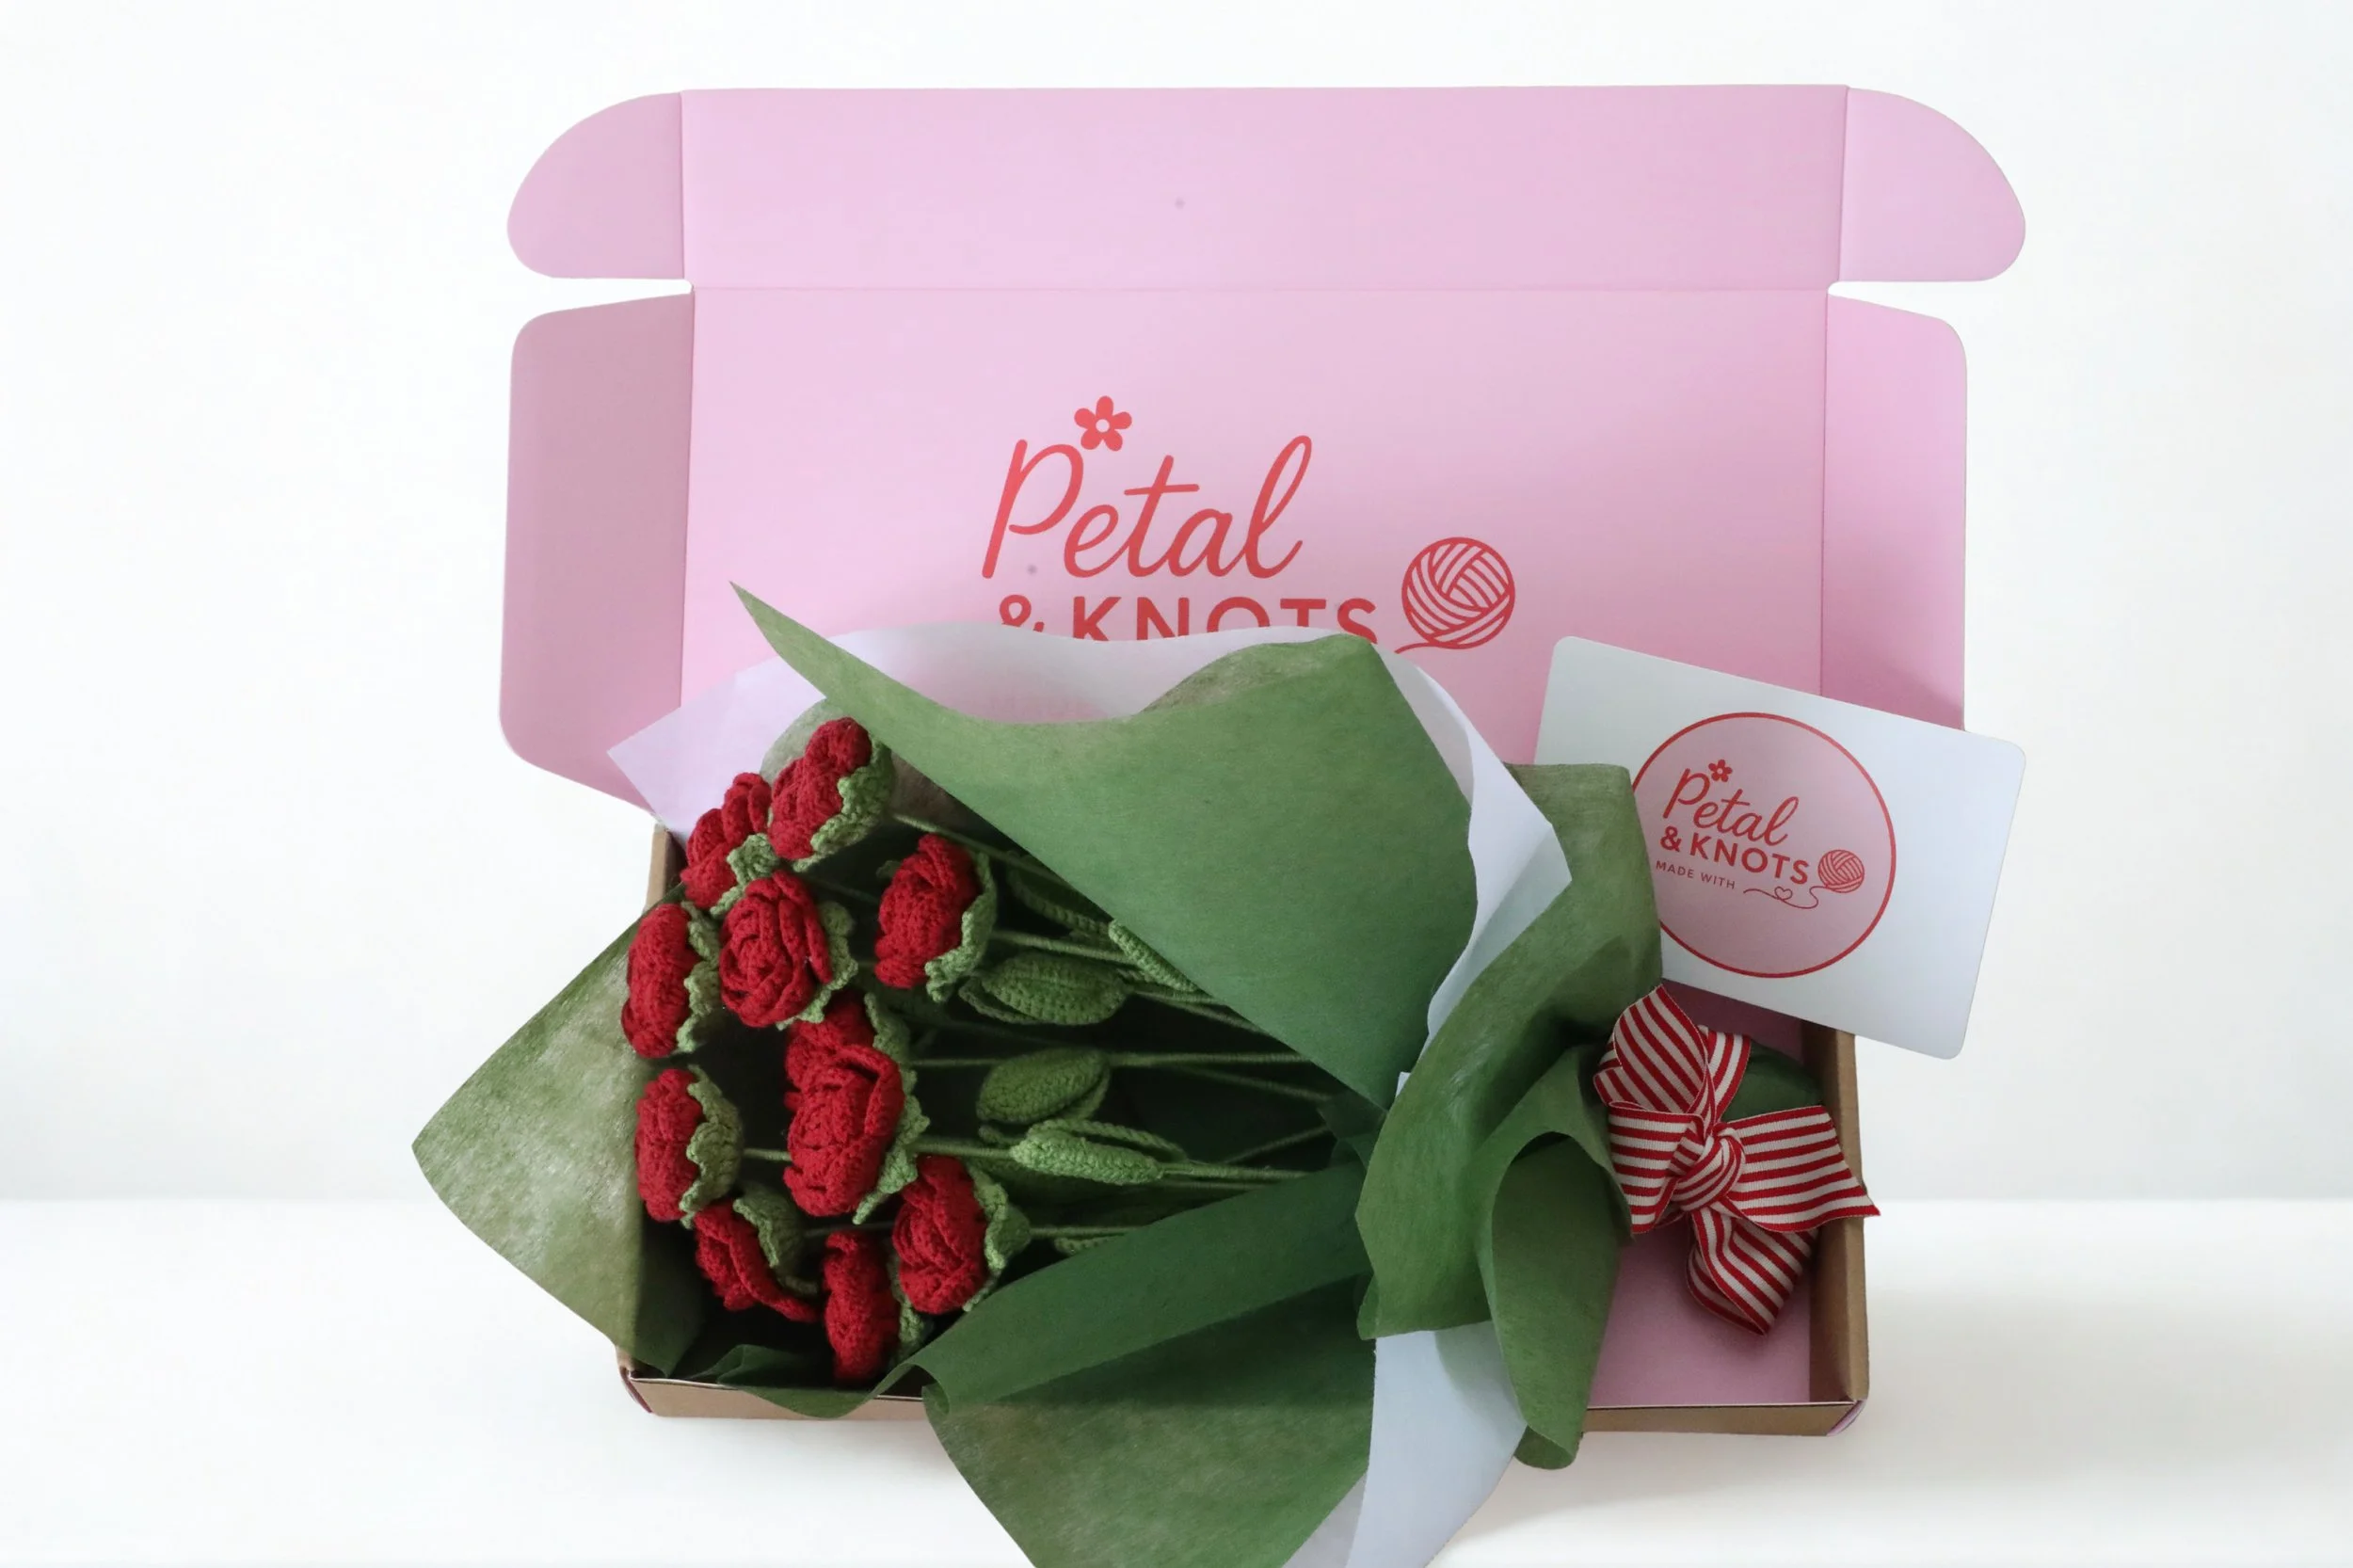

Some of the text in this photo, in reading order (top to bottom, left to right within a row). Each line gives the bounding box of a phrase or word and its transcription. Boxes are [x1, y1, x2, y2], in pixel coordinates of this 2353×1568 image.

[982, 435, 1313, 580] Petal
[1072, 595, 1378, 644] KNOTS
[1663, 768, 1799, 845] Petal
[1656, 859, 1736, 890] MADE WITH
[1659, 825, 1809, 885] & KNOTS
